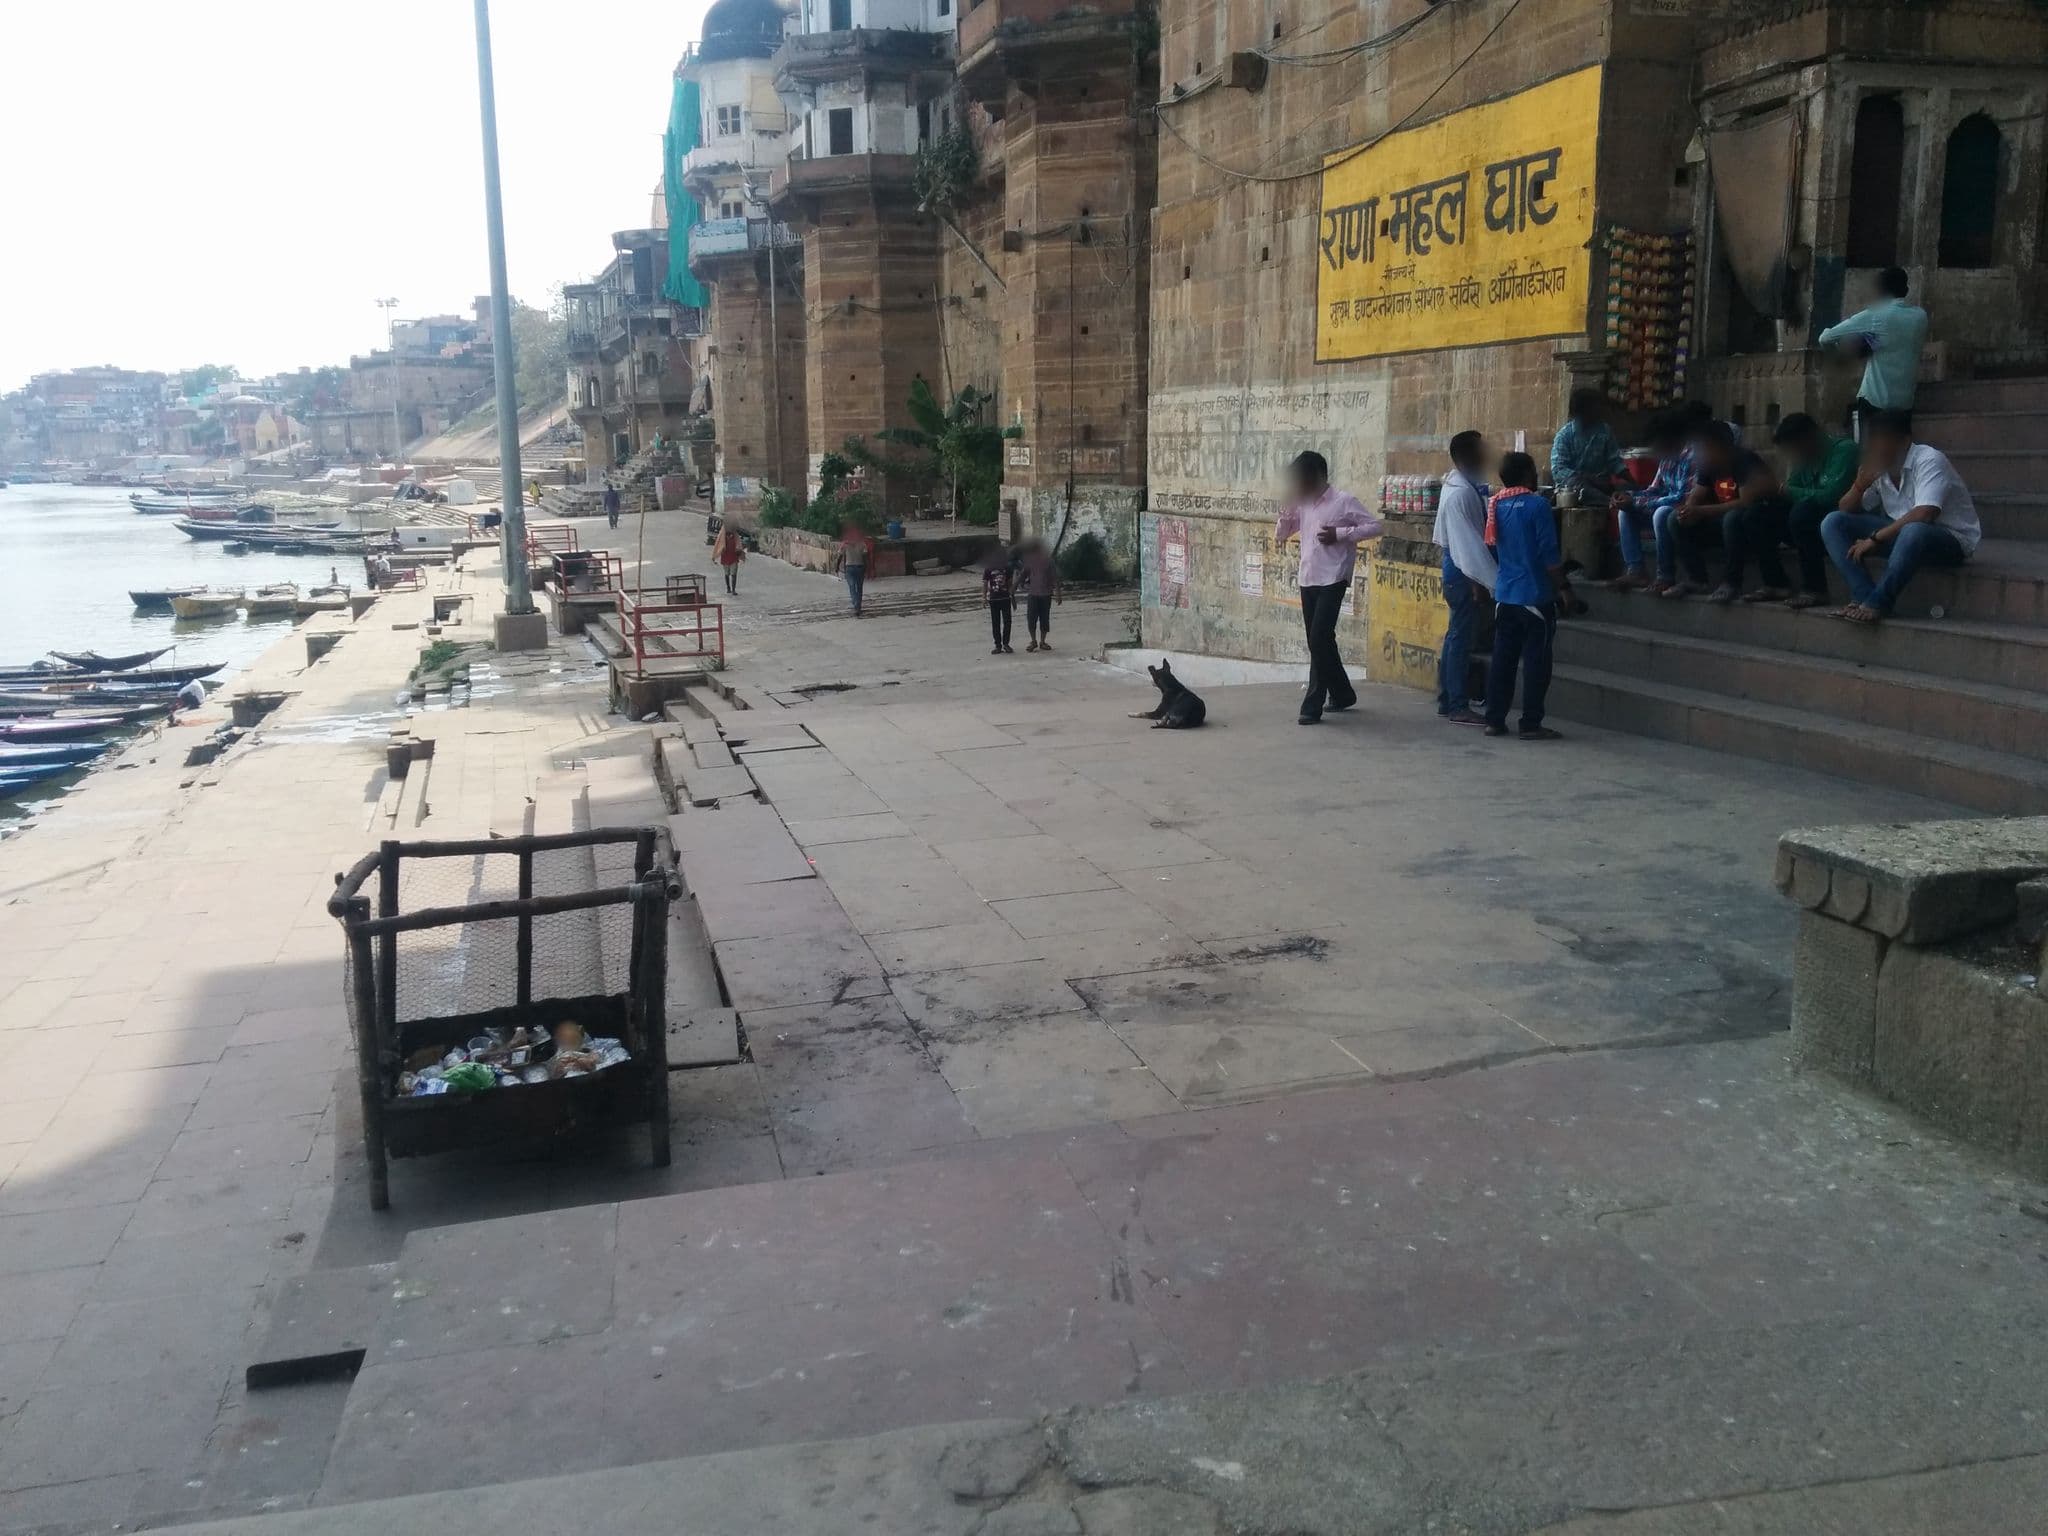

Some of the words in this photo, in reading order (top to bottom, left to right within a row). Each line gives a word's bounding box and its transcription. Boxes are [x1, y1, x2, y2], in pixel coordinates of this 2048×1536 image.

[1321, 196, 1380, 271] राणा
[1389, 171, 1470, 256] महल
[1484, 146, 1563, 235] घाट
[1330, 300, 1350, 328] सुलभ
[1449, 275, 1481, 309] सर्विस
